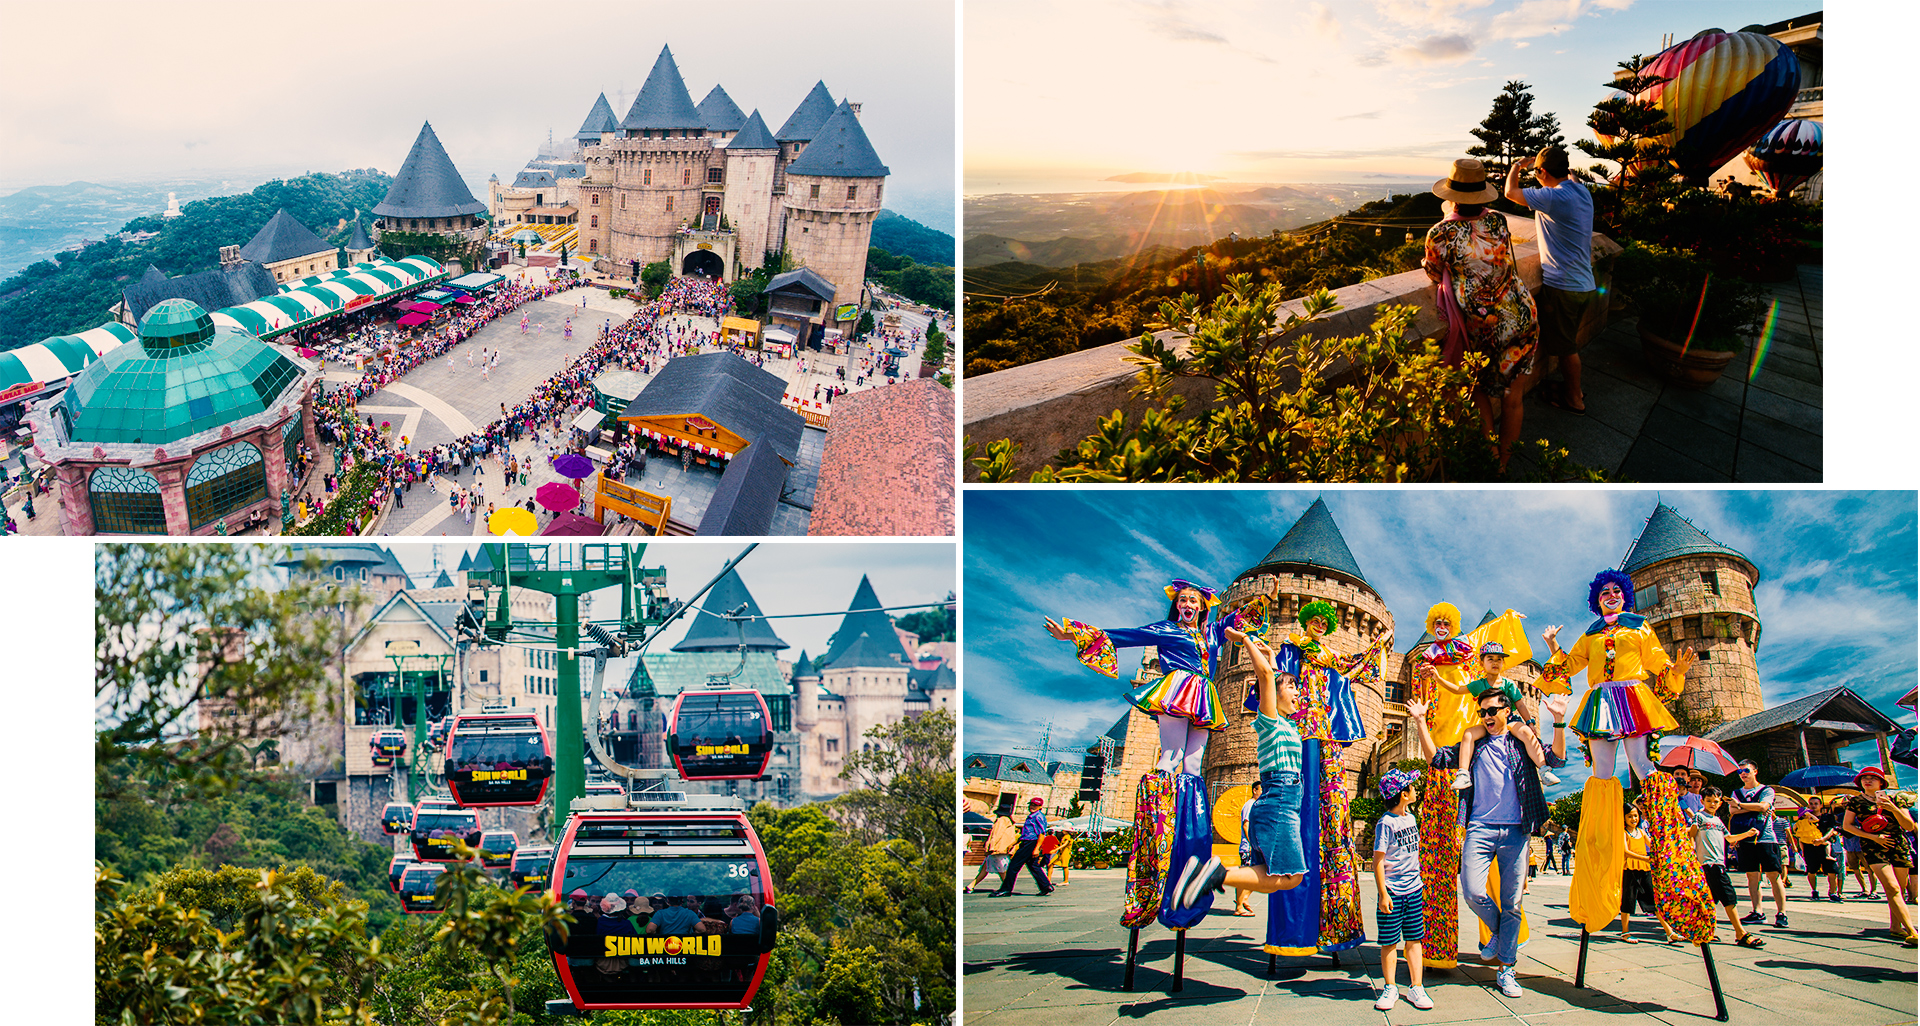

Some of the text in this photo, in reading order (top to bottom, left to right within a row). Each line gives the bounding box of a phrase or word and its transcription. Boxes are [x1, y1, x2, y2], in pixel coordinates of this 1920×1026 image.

[750, 712, 760, 720] 39
[528, 736, 539, 745] 45
[696, 744, 750, 756] SUN WORLD
[472, 769, 527, 782] SUN WORLD
[728, 863, 749, 878] 36
[605, 934, 722, 957] SUN WORLD
[639, 957, 687, 965] BA NA HILLS
